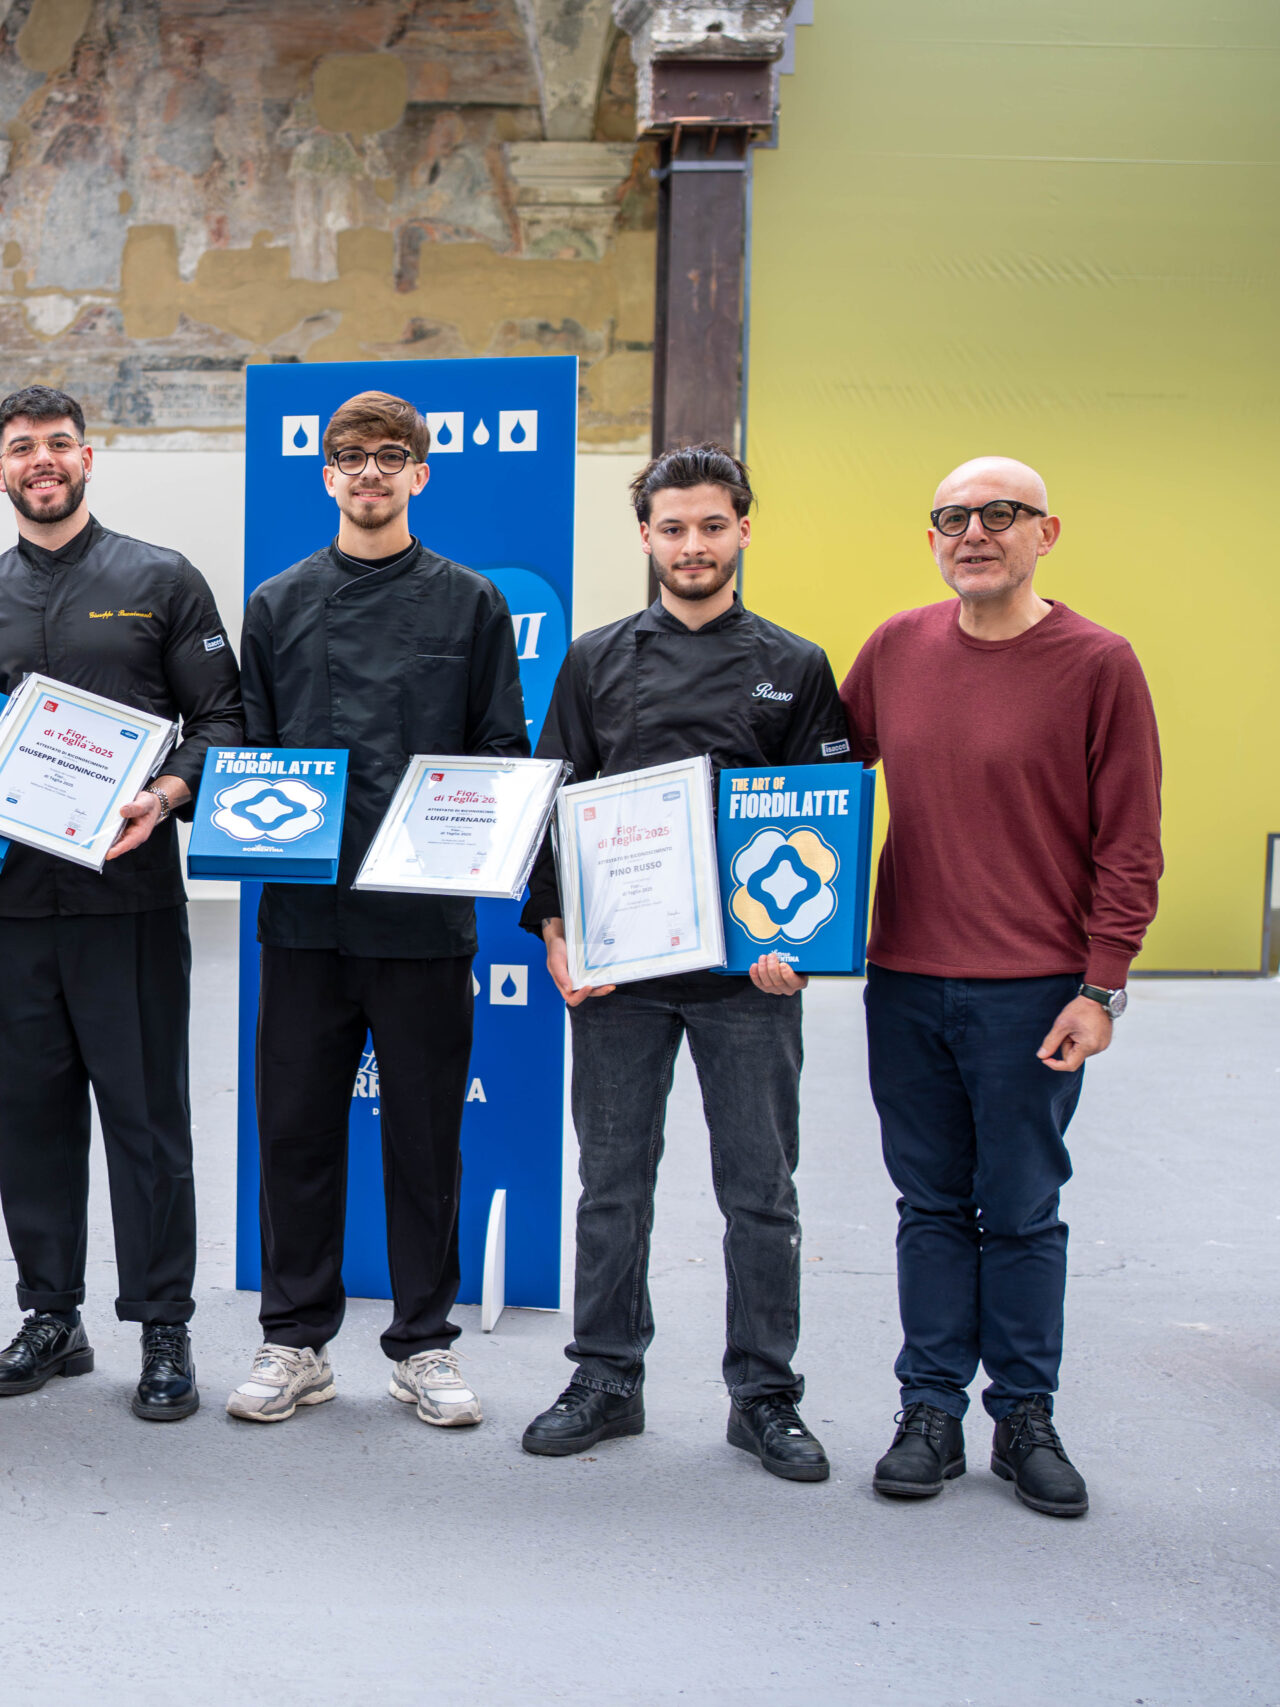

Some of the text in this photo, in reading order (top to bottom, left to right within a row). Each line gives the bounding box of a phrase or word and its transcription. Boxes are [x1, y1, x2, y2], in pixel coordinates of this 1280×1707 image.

[752, 682, 793, 701] Russo
[43, 728, 115, 759] di Teglia 2025
[218, 751, 273, 760] THE ART OF
[19, 745, 56, 764] GIUSEPPE
[57, 759, 117, 785] BUONINCONTI
[215, 760, 336, 775] FIORDILATTE
[731, 776, 786, 792] THE ART OF
[447, 795, 479, 804] Teglia
[729, 789, 849, 819] FIORDILATTE
[598, 826, 670, 849] di Teglia 2025
[610, 860, 662, 878] PINO RUSSO
